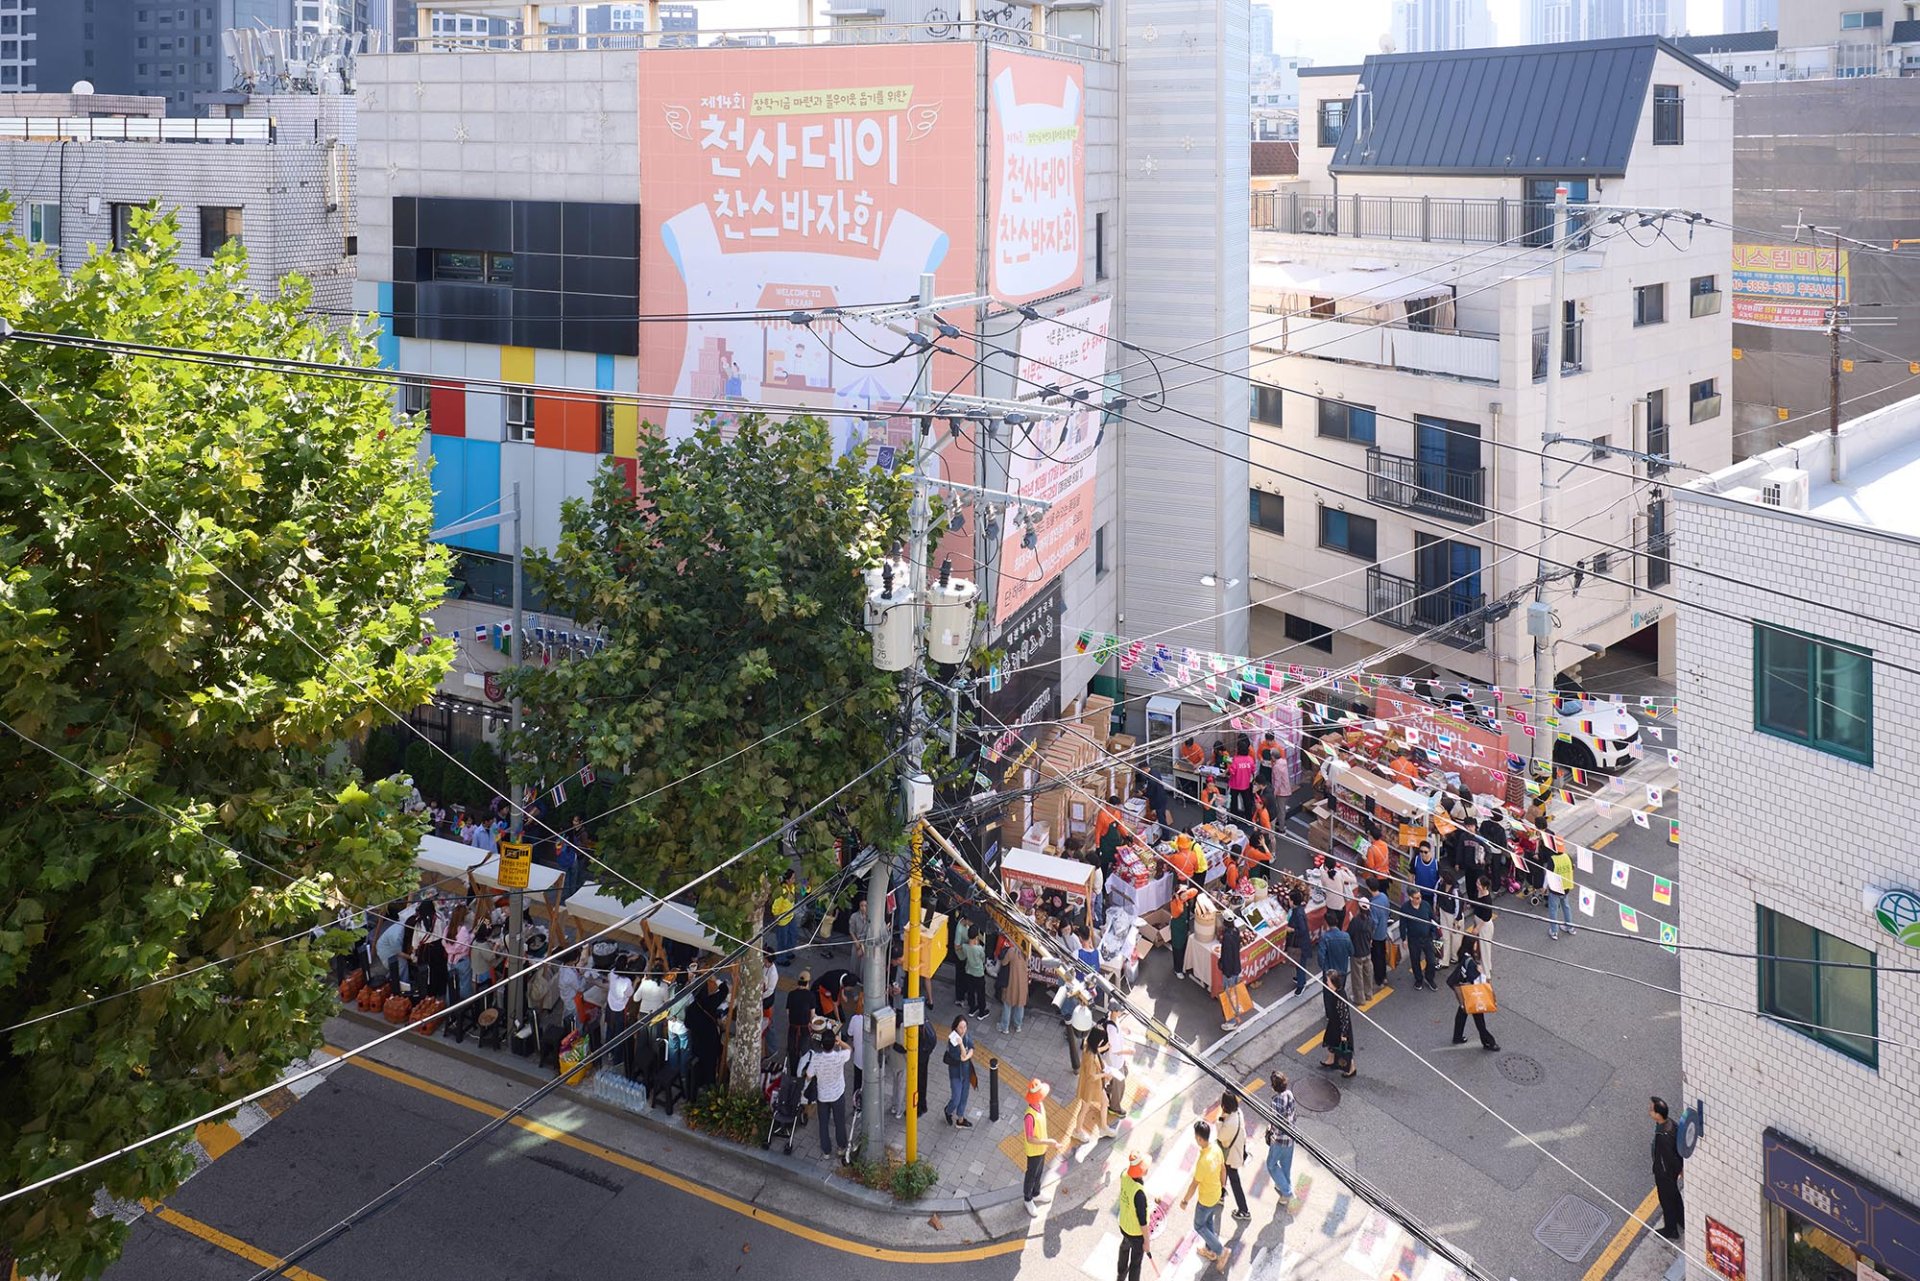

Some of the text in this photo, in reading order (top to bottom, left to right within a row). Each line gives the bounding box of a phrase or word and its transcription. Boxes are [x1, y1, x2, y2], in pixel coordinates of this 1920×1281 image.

[700, 91, 745, 110] 제14회
[794, 94, 823, 110] 마련과
[826, 92, 857, 109] 불우이웃
[859, 90, 885, 106] 돕기를
[887, 89, 907, 104] 위한
[700, 114, 898, 185] 천사데이
[1008, 153, 1071, 203] 천사데이
[713, 188, 884, 251] 찬스바자회
[1000, 208, 1077, 264] 찬스바자회
[877, 648, 887, 660] 75
